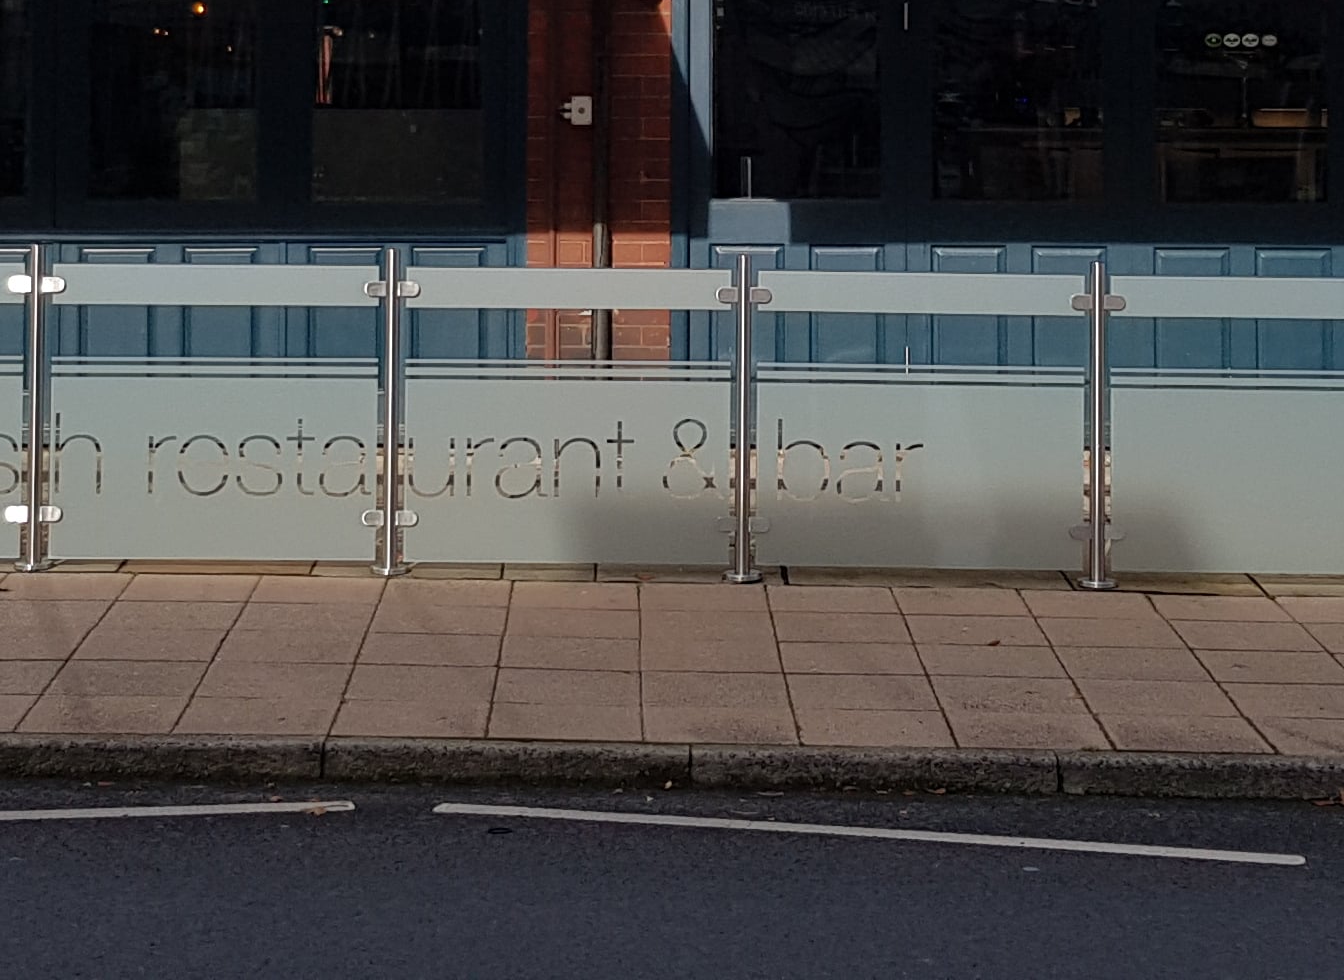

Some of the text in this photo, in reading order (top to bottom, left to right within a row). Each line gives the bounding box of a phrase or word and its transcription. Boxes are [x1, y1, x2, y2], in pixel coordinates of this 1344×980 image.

[146, 417, 636, 500] restaurant
[660, 417, 727, 501] &
[777, 417, 925, 503] bar
